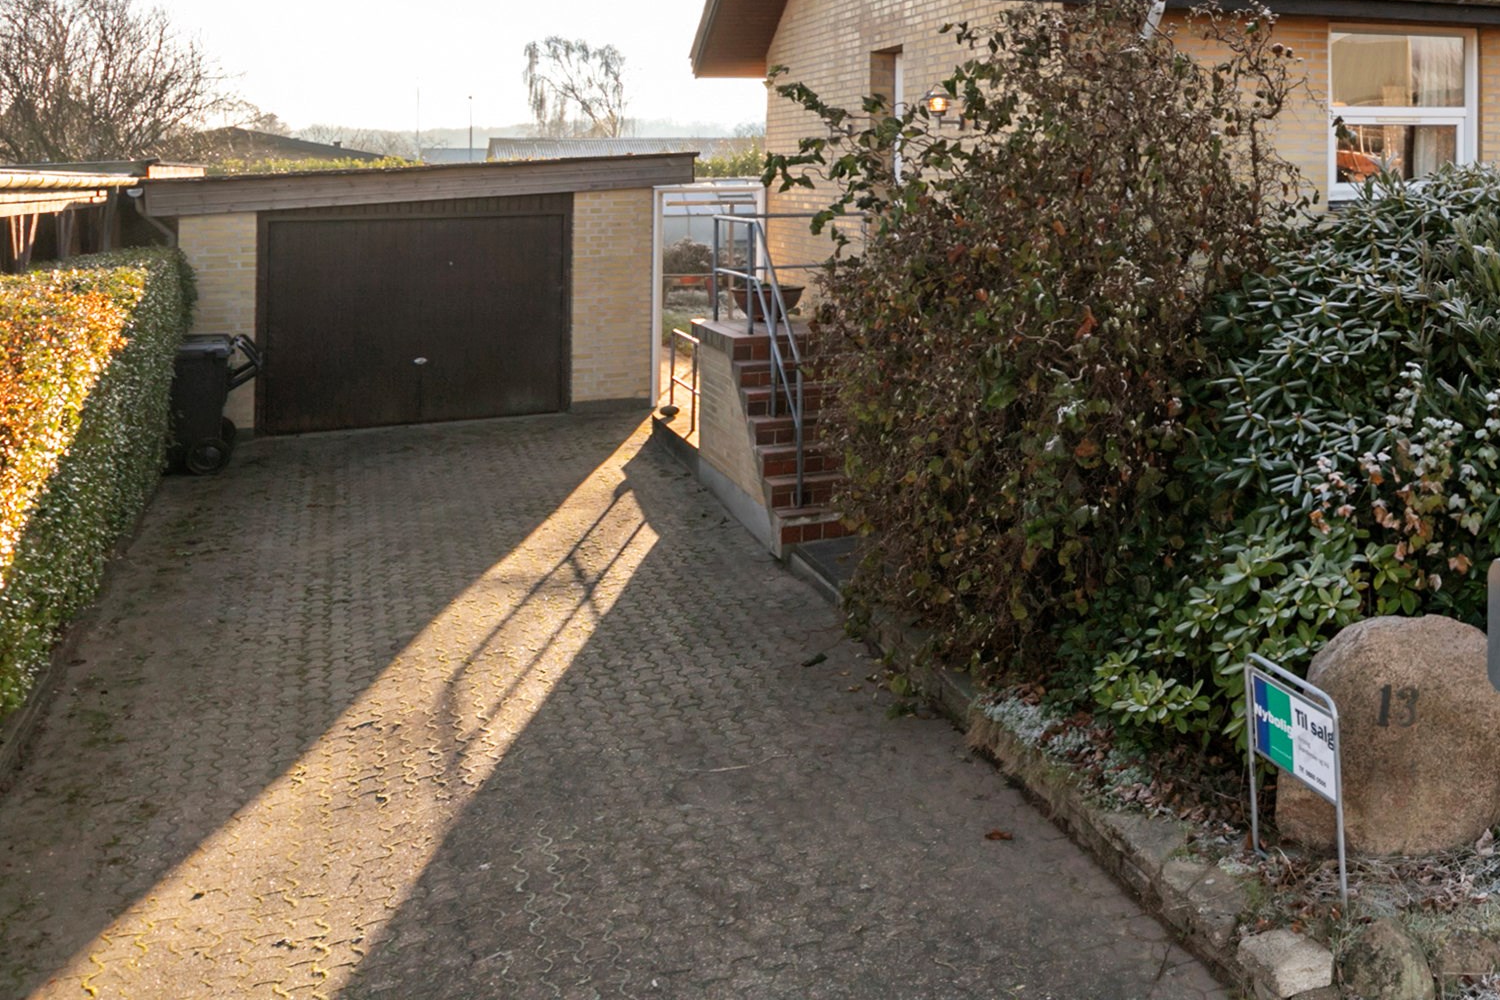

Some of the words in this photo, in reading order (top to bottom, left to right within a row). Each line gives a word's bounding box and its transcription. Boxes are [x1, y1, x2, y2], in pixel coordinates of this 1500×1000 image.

[1254, 703, 1294, 739] Nybolig
[1377, 684, 1420, 728] 13
[1295, 708, 1308, 730] Til
[1310, 721, 1335, 751] salg
